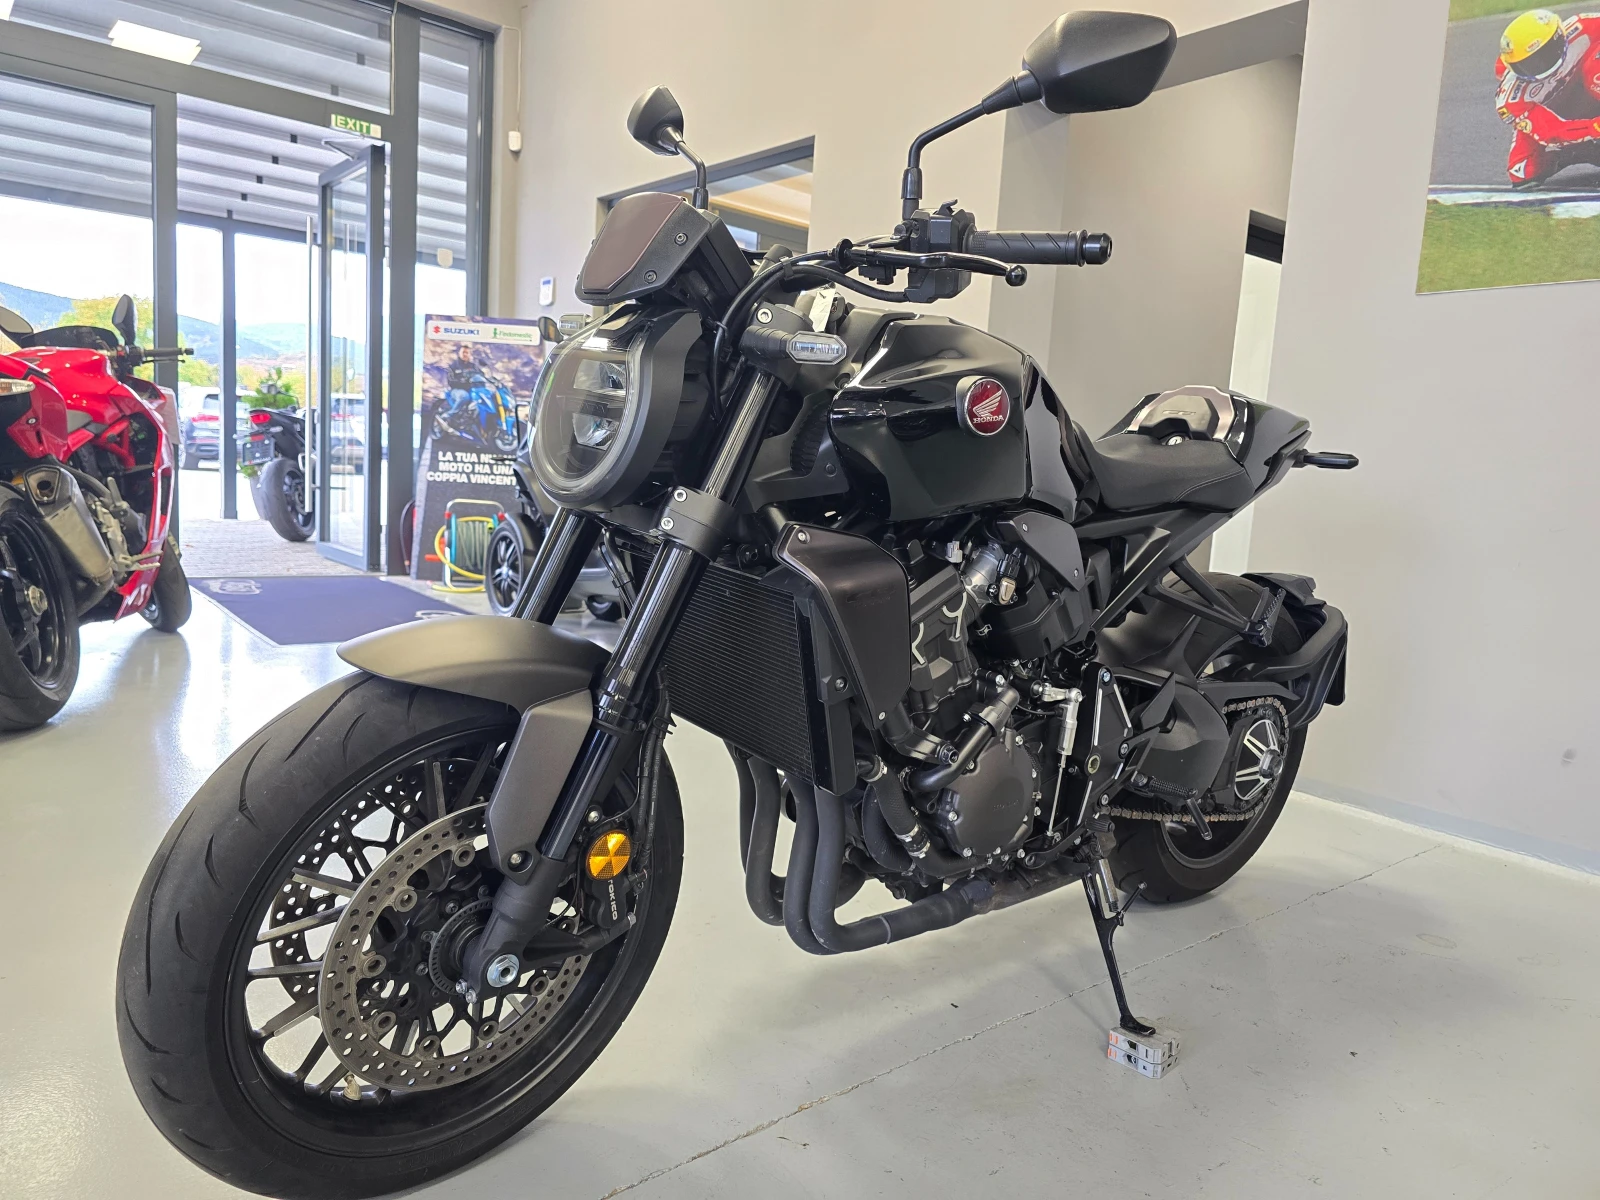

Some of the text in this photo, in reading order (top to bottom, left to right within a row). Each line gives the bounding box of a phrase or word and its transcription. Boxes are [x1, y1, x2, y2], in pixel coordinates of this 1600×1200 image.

[336, 115, 370, 134] EXIT
[443, 326, 480, 336] SUZUKI
[972, 414, 1004, 424] HONDA
[438, 451, 453, 461] LA
[455, 452, 478, 463] TUA
[438, 462, 473, 473] MOTO
[474, 464, 491, 474] HA
[426, 471, 517, 486] COPPIA VINCENT
